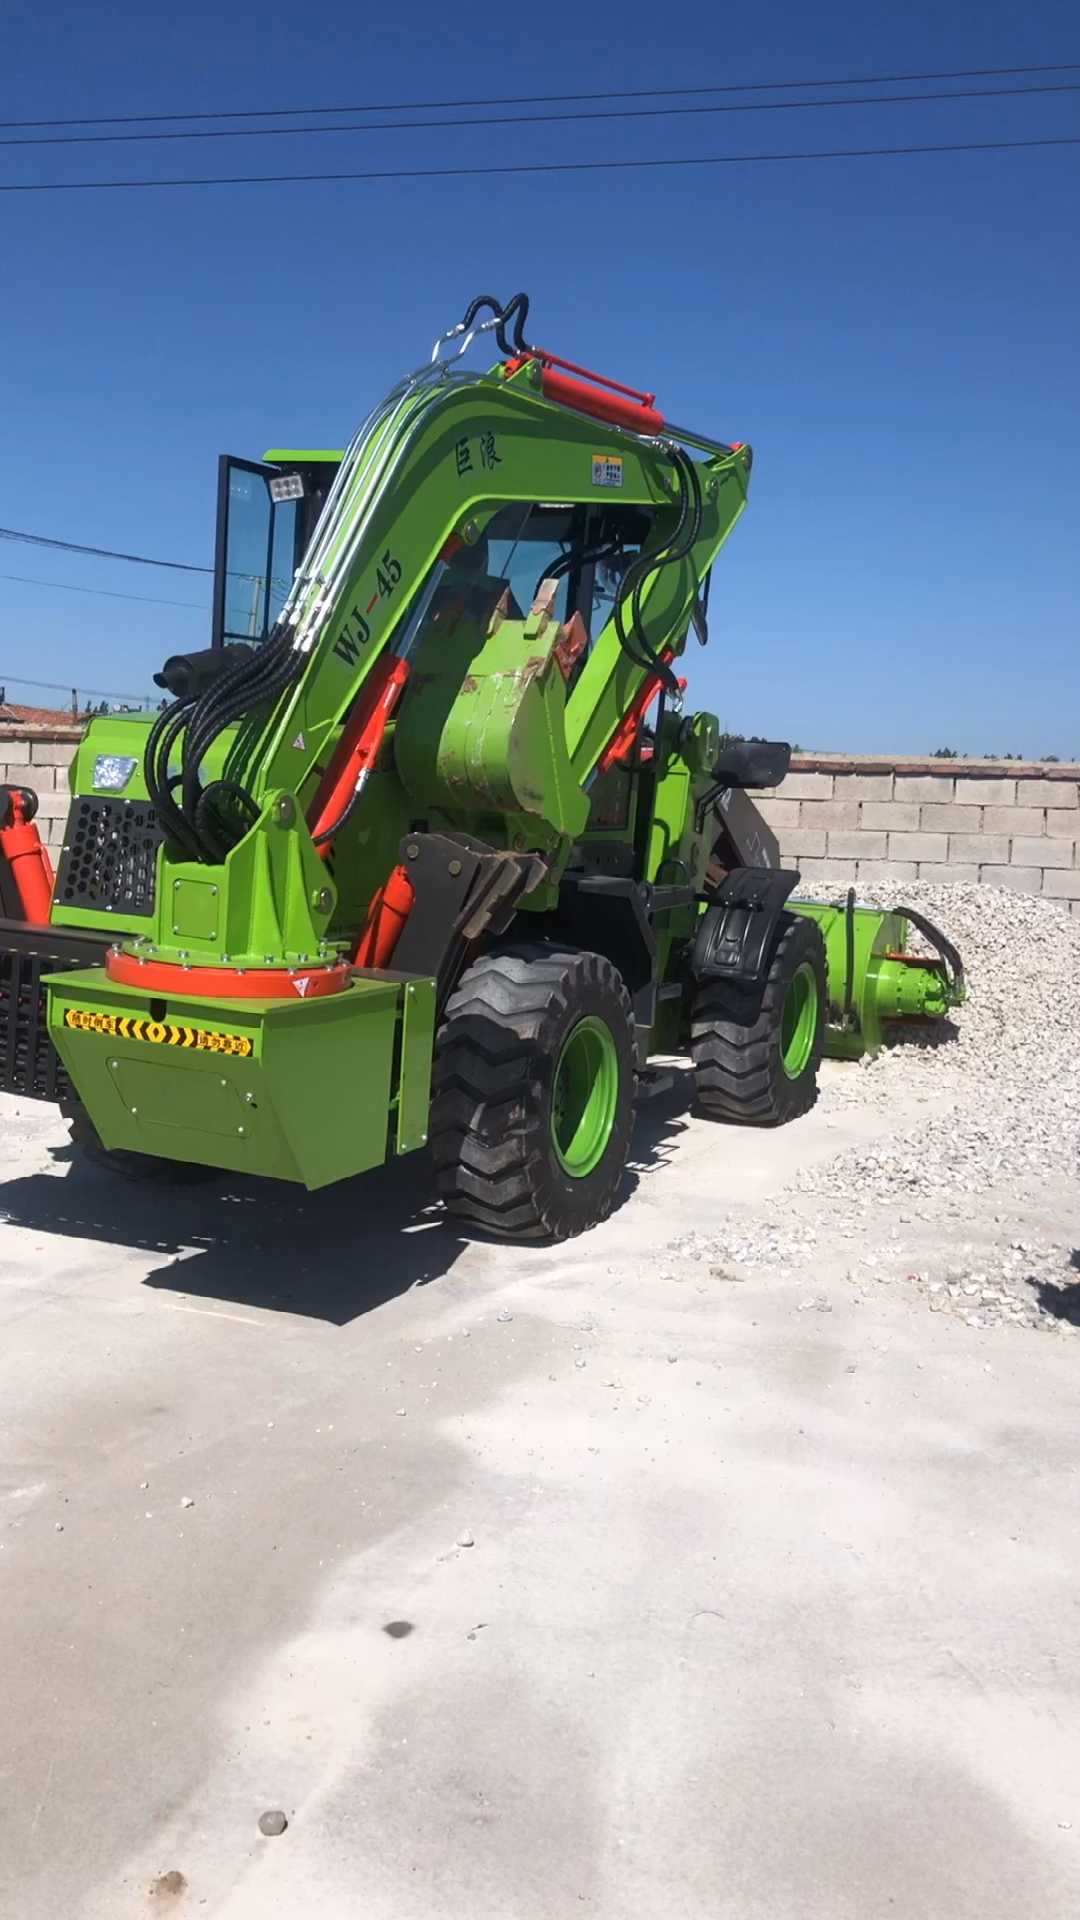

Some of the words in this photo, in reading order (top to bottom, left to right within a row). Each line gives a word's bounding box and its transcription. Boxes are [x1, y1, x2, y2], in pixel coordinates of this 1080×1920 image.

[455, 430, 503, 477] 巨浪
[199, 1034, 245, 1051] 请勿靠近
